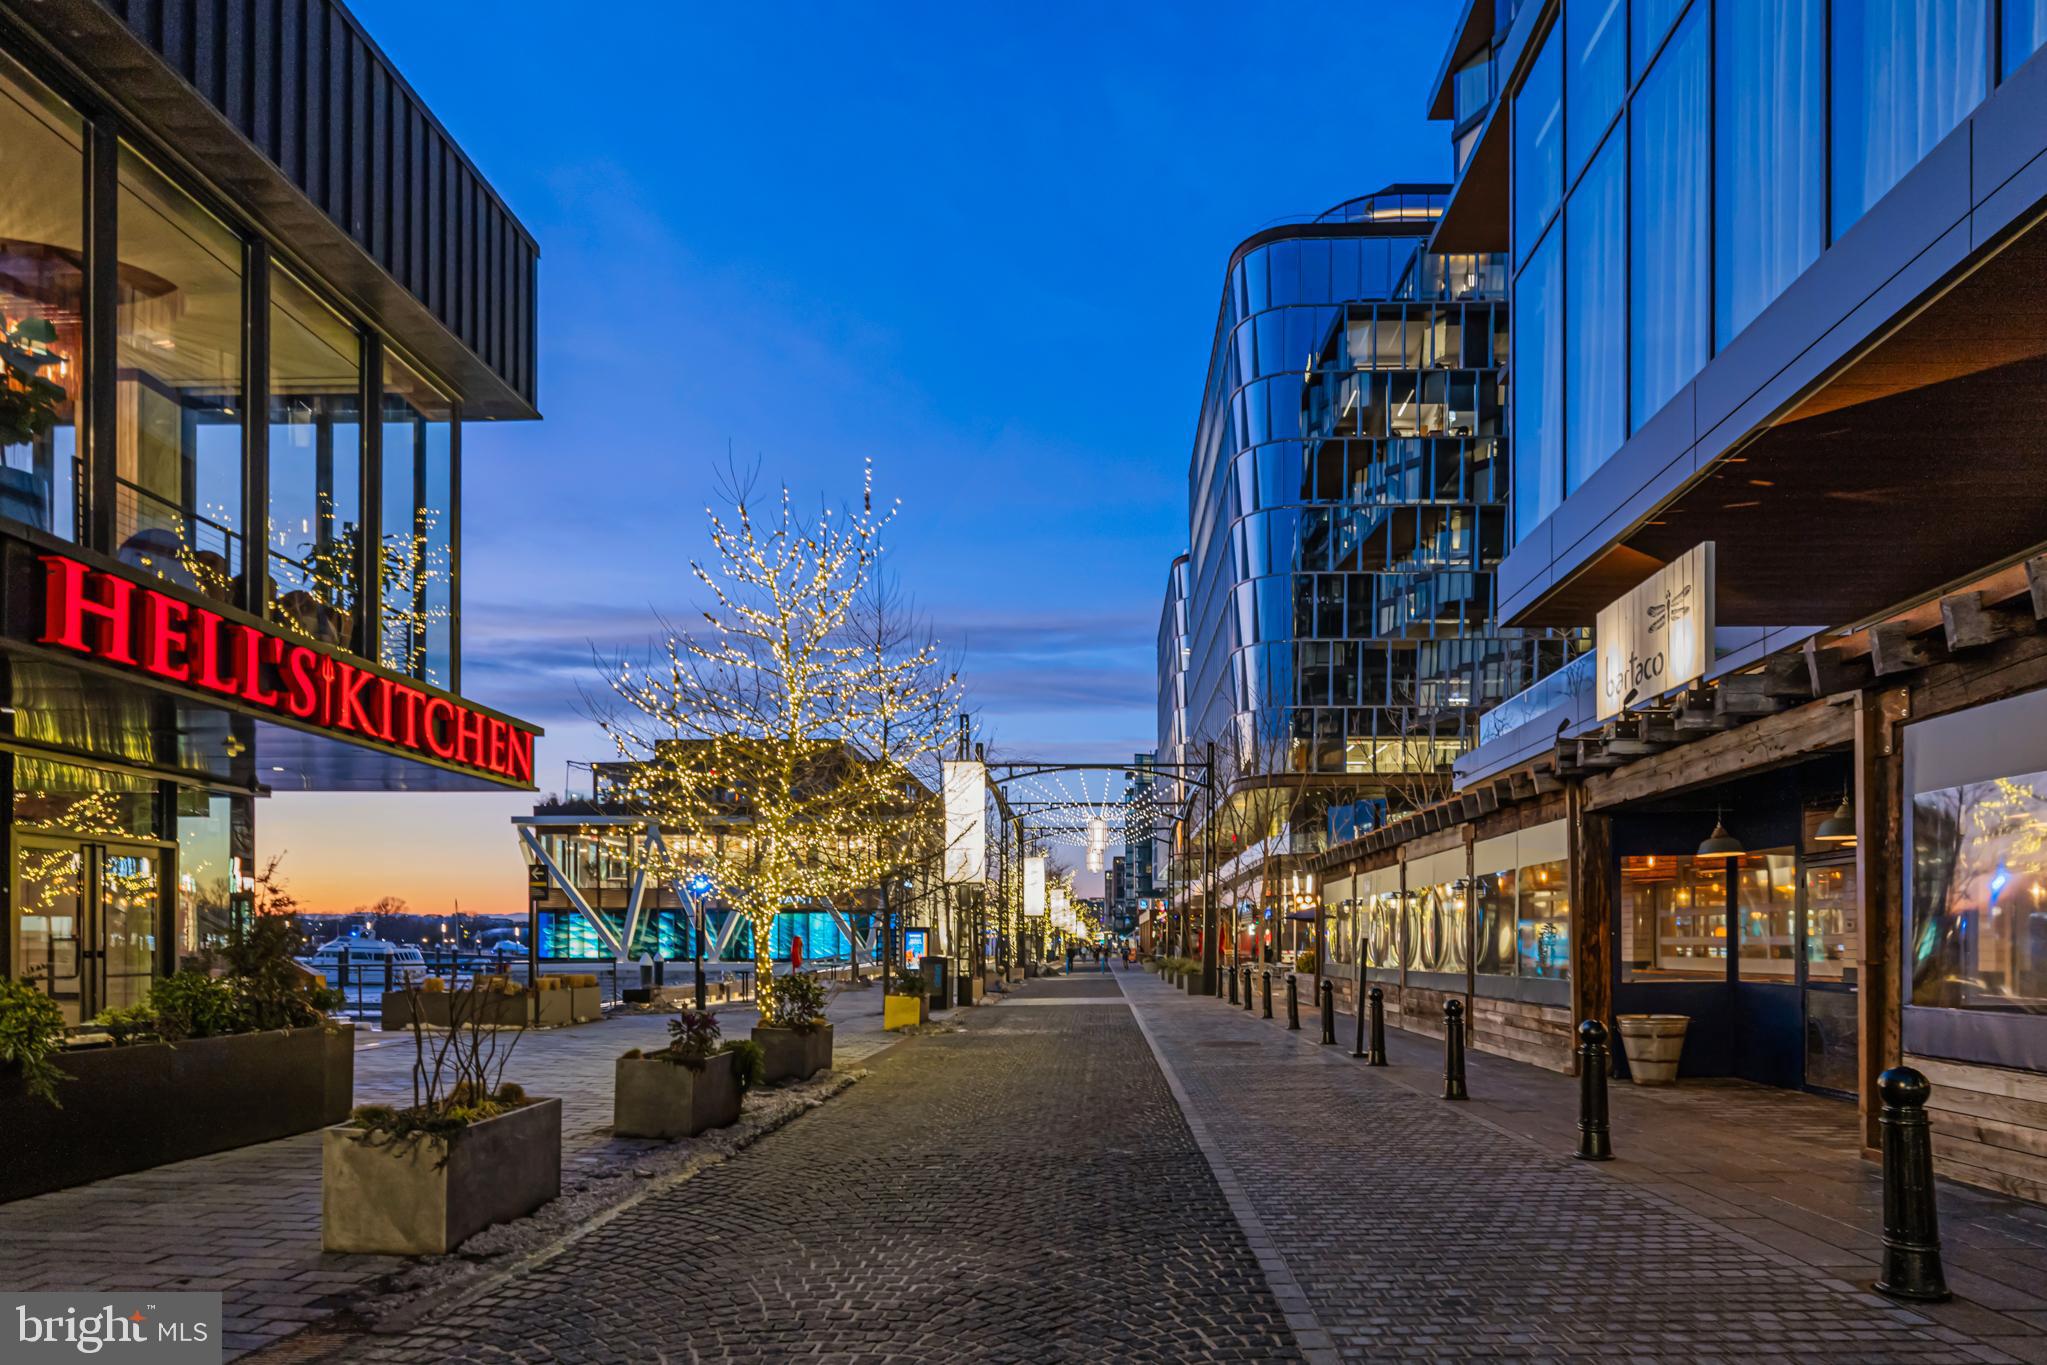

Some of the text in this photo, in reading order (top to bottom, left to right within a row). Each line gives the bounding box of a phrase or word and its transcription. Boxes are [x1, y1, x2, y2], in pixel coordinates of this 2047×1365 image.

[38, 554, 535, 782] HELL'S KITCHEN
[1605, 651, 1664, 697] bartaco
